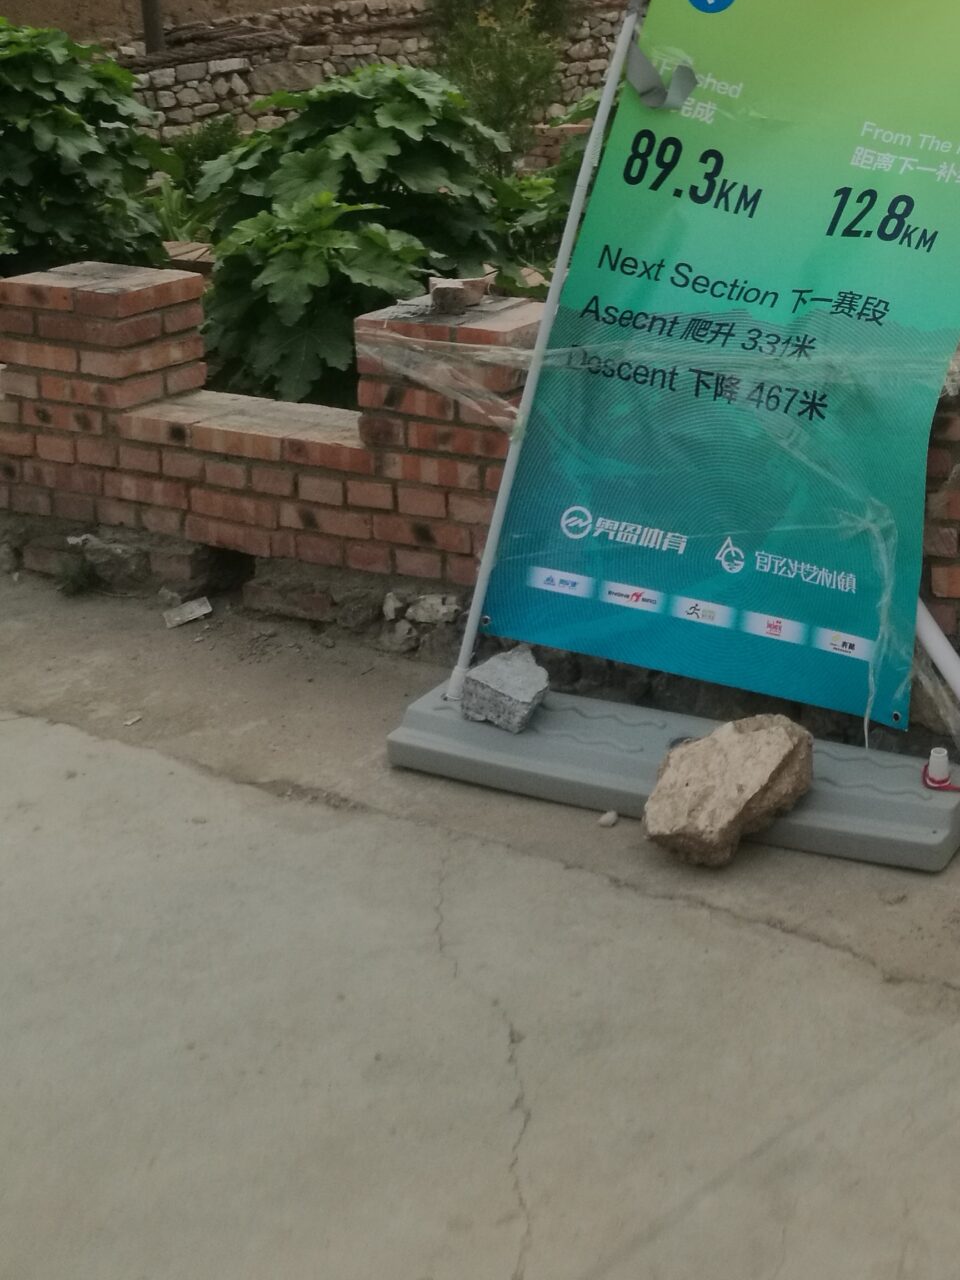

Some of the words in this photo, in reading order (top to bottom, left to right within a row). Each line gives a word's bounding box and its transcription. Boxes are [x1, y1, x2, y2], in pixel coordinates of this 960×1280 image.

[659, 59, 744, 99] Fshed
[860, 121, 912, 148] From
[917, 132, 953, 154] The
[622, 129, 763, 219] 89.3KM
[825, 186, 939, 253] 12.8KM
[598, 244, 665, 282] Next
[670, 262, 779, 309] Section
[791, 288, 891, 326] 下一赛段
[580, 296, 685, 338] Asecnt
[681, 317, 737, 348] 爬升
[689, 367, 741, 403] 下降
[746, 384, 829, 421] 467米
